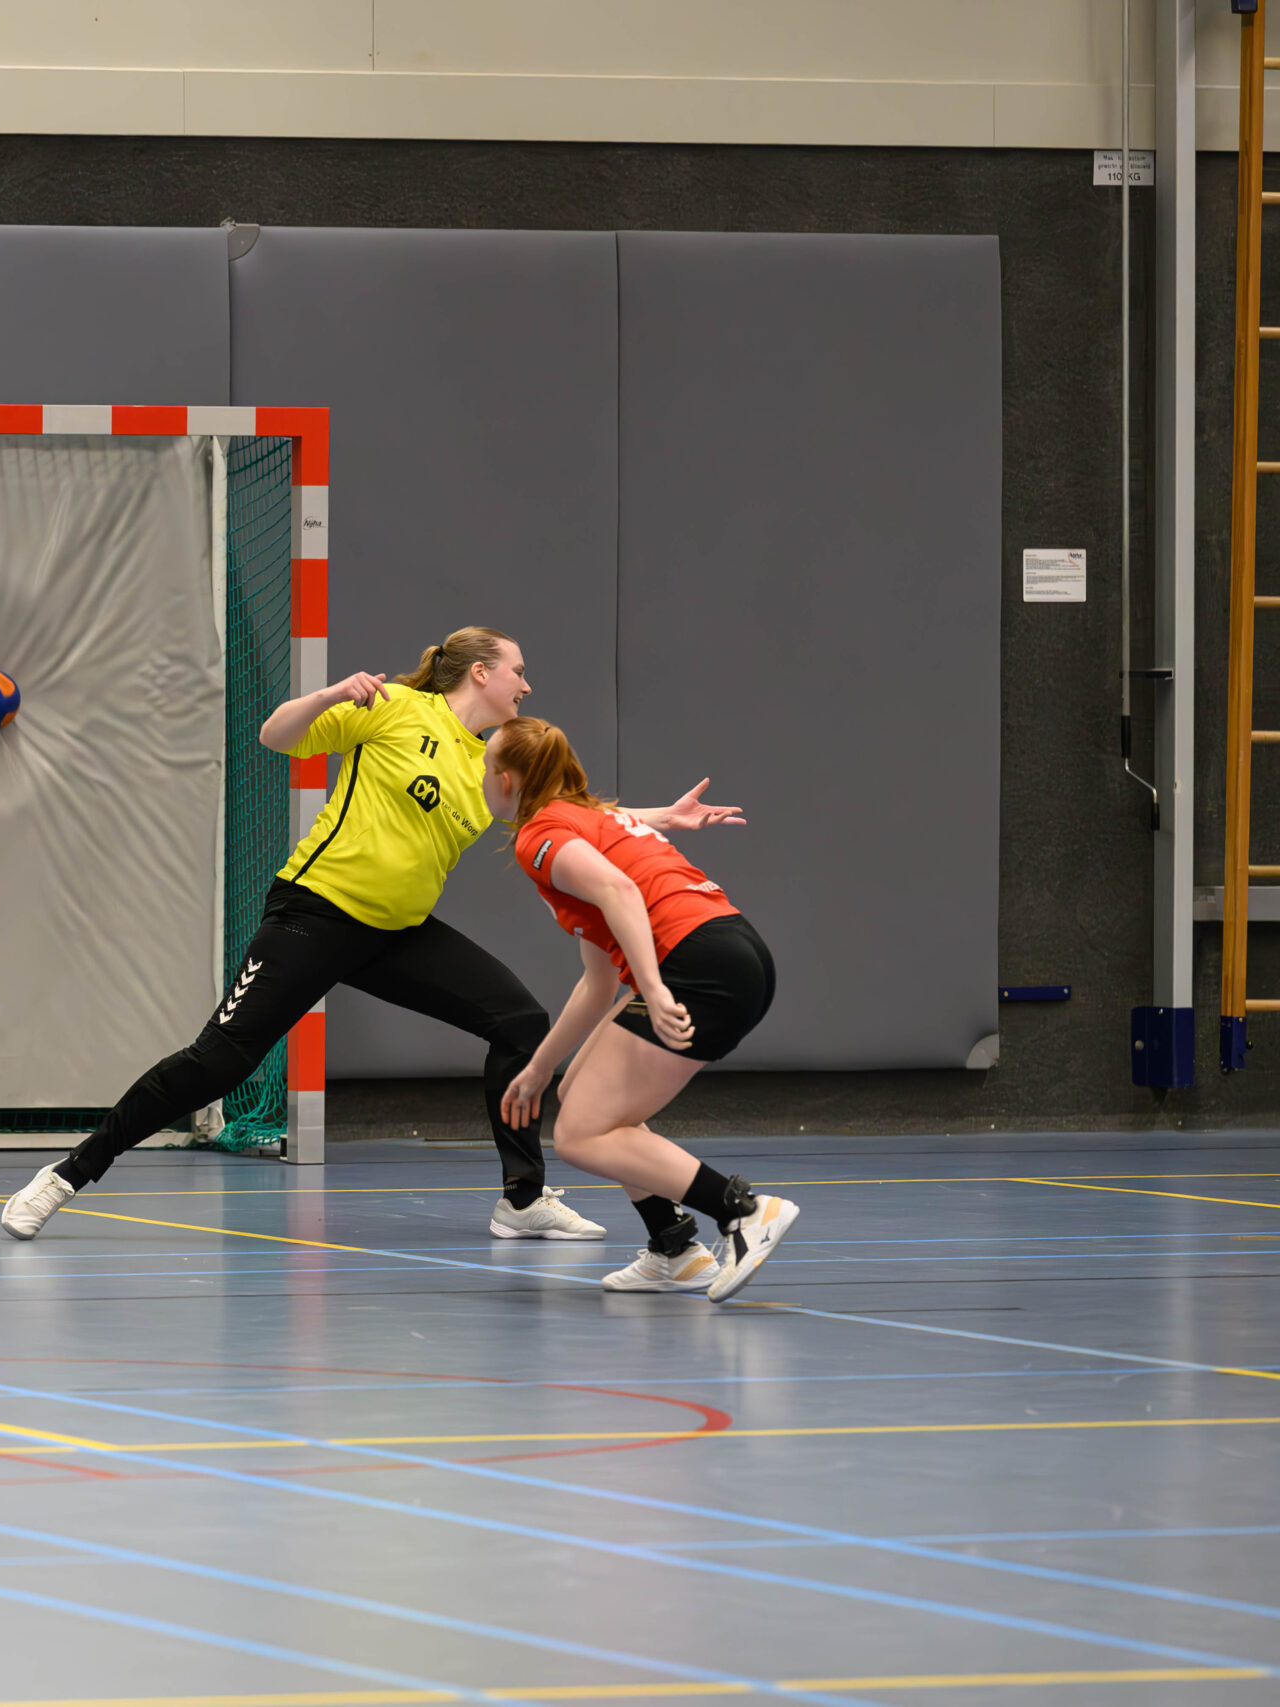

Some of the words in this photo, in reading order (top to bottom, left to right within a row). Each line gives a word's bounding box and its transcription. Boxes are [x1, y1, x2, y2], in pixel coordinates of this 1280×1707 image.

[1108, 172, 1123, 181] 110
[419, 735, 439, 760] 11
[451, 811, 461, 822] de
[461, 817, 479, 837] Worp
